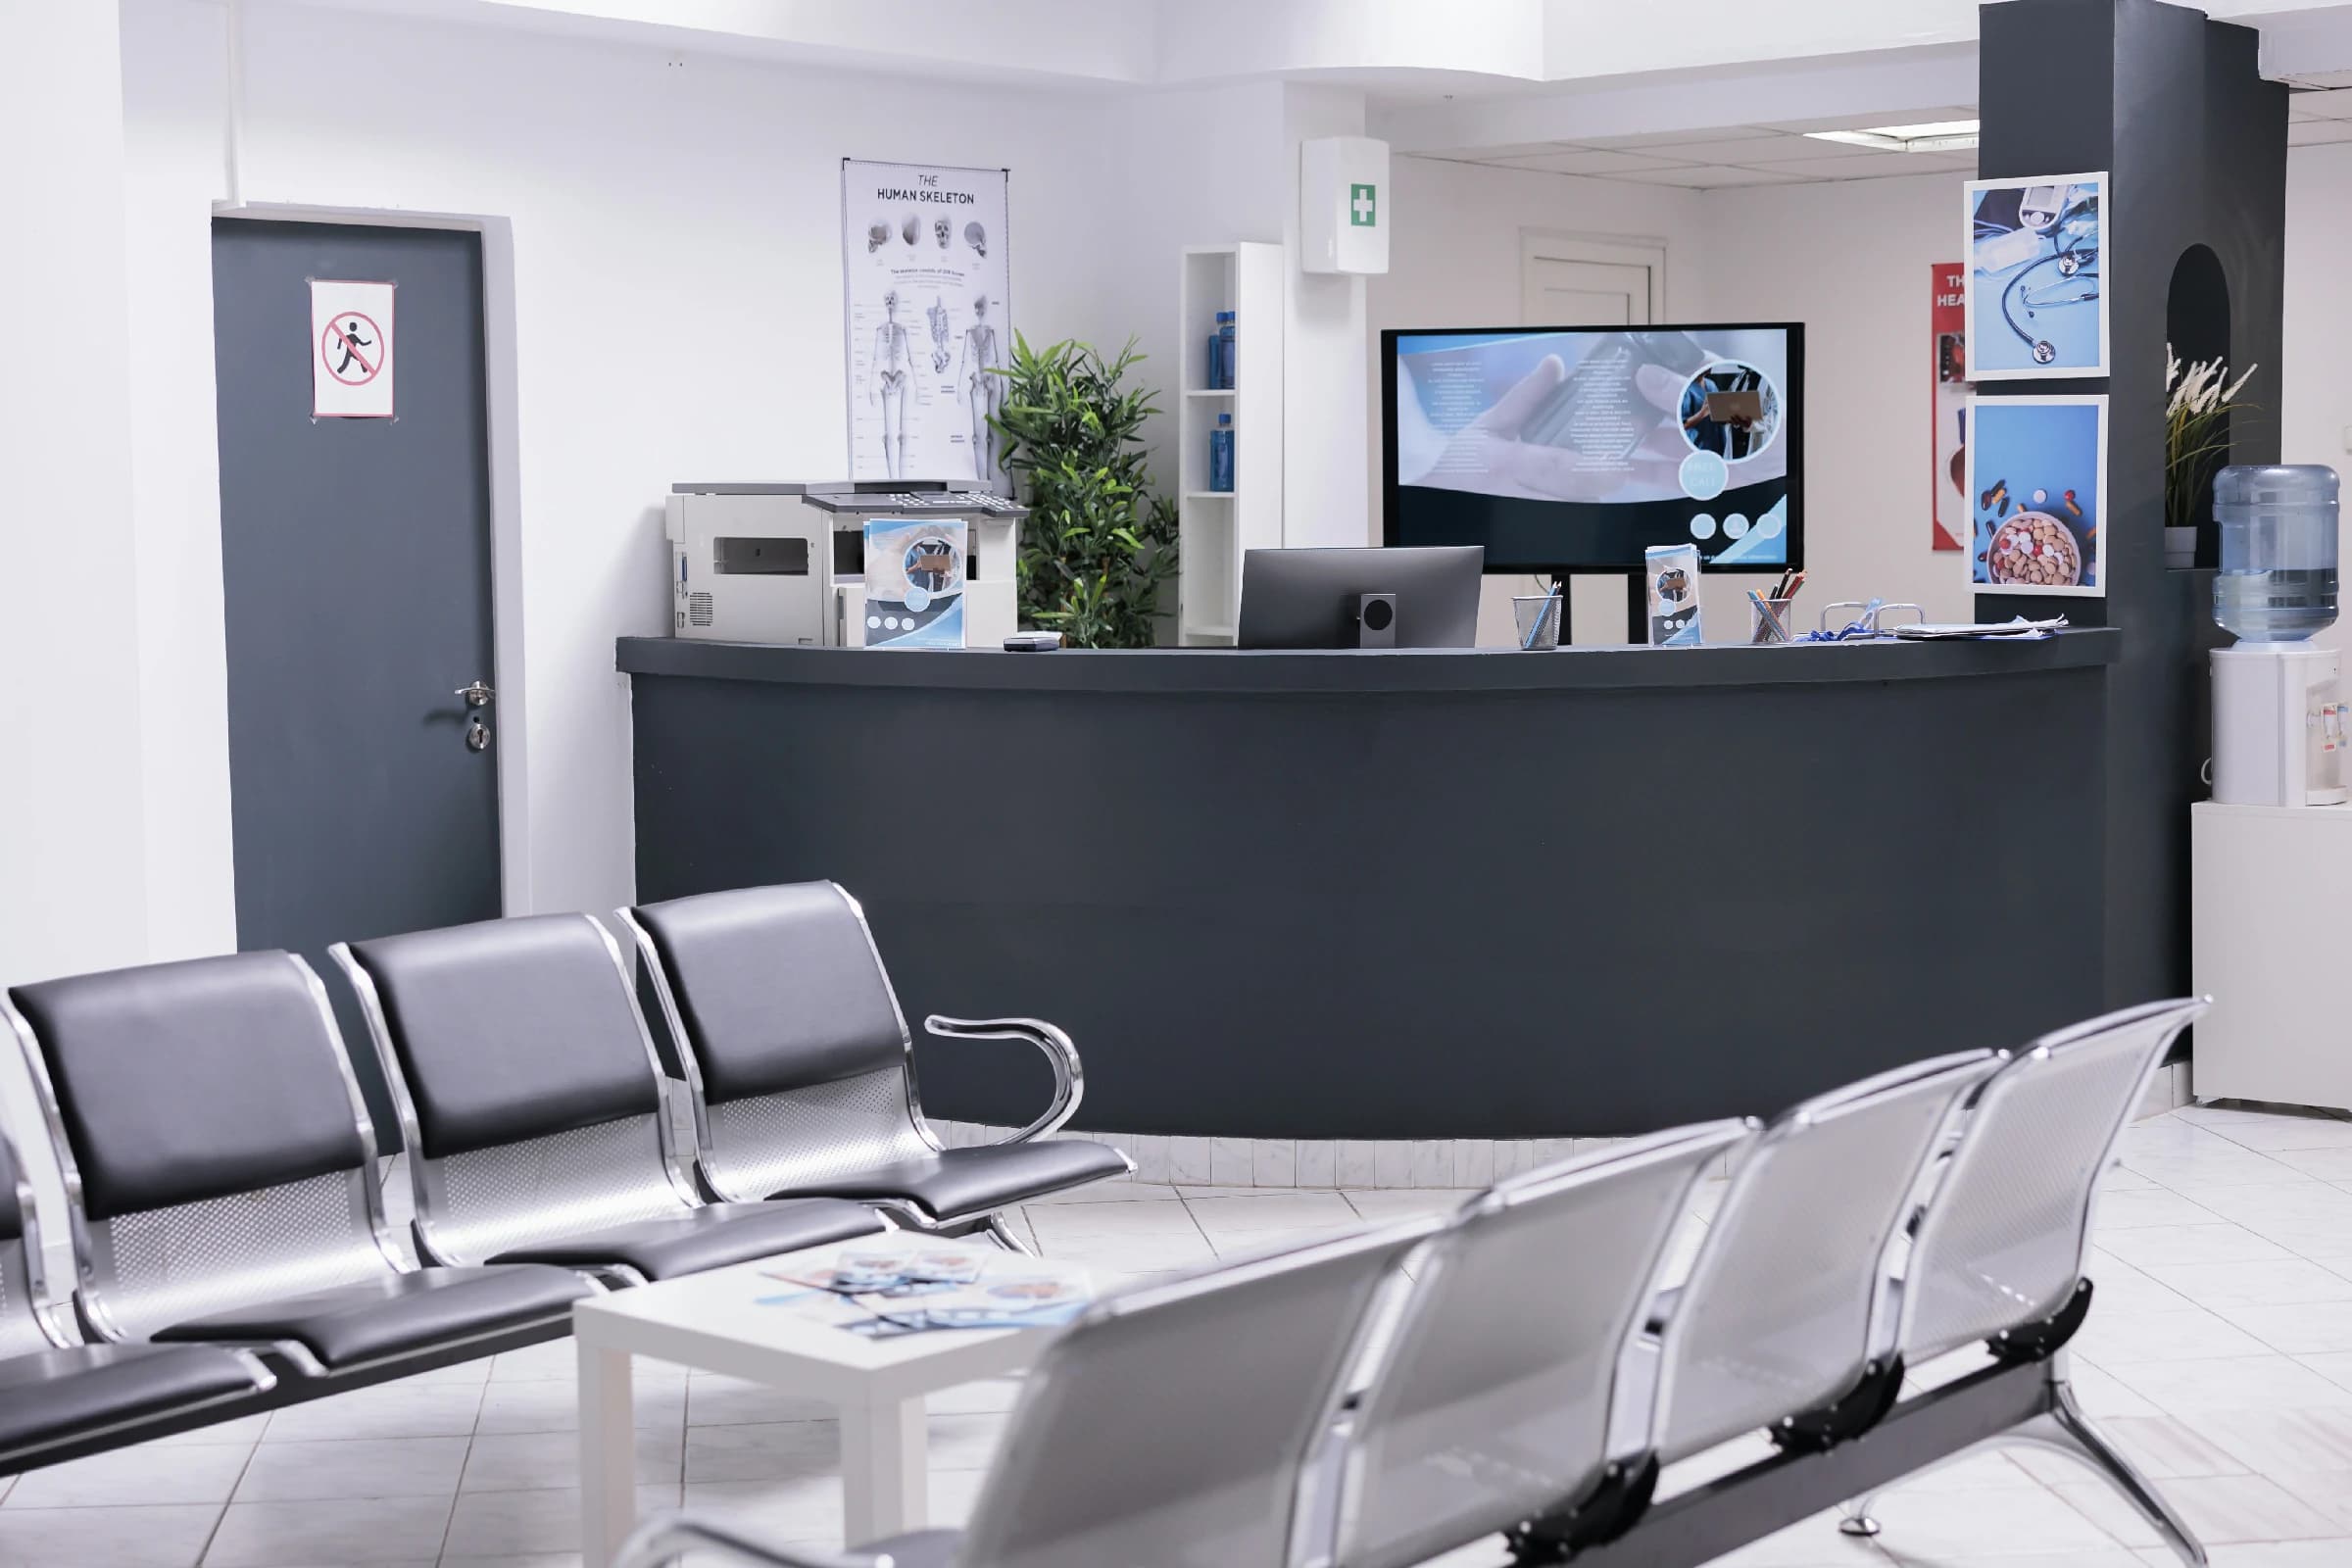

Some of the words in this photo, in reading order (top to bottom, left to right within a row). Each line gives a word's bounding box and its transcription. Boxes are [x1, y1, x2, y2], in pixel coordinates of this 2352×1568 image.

[917, 174, 939, 187] THE
[877, 187, 917, 201] HUMAN
[919, 189, 974, 205] SKELETON
[1946, 274, 1965, 287] TH
[1936, 294, 1965, 307] HEA
